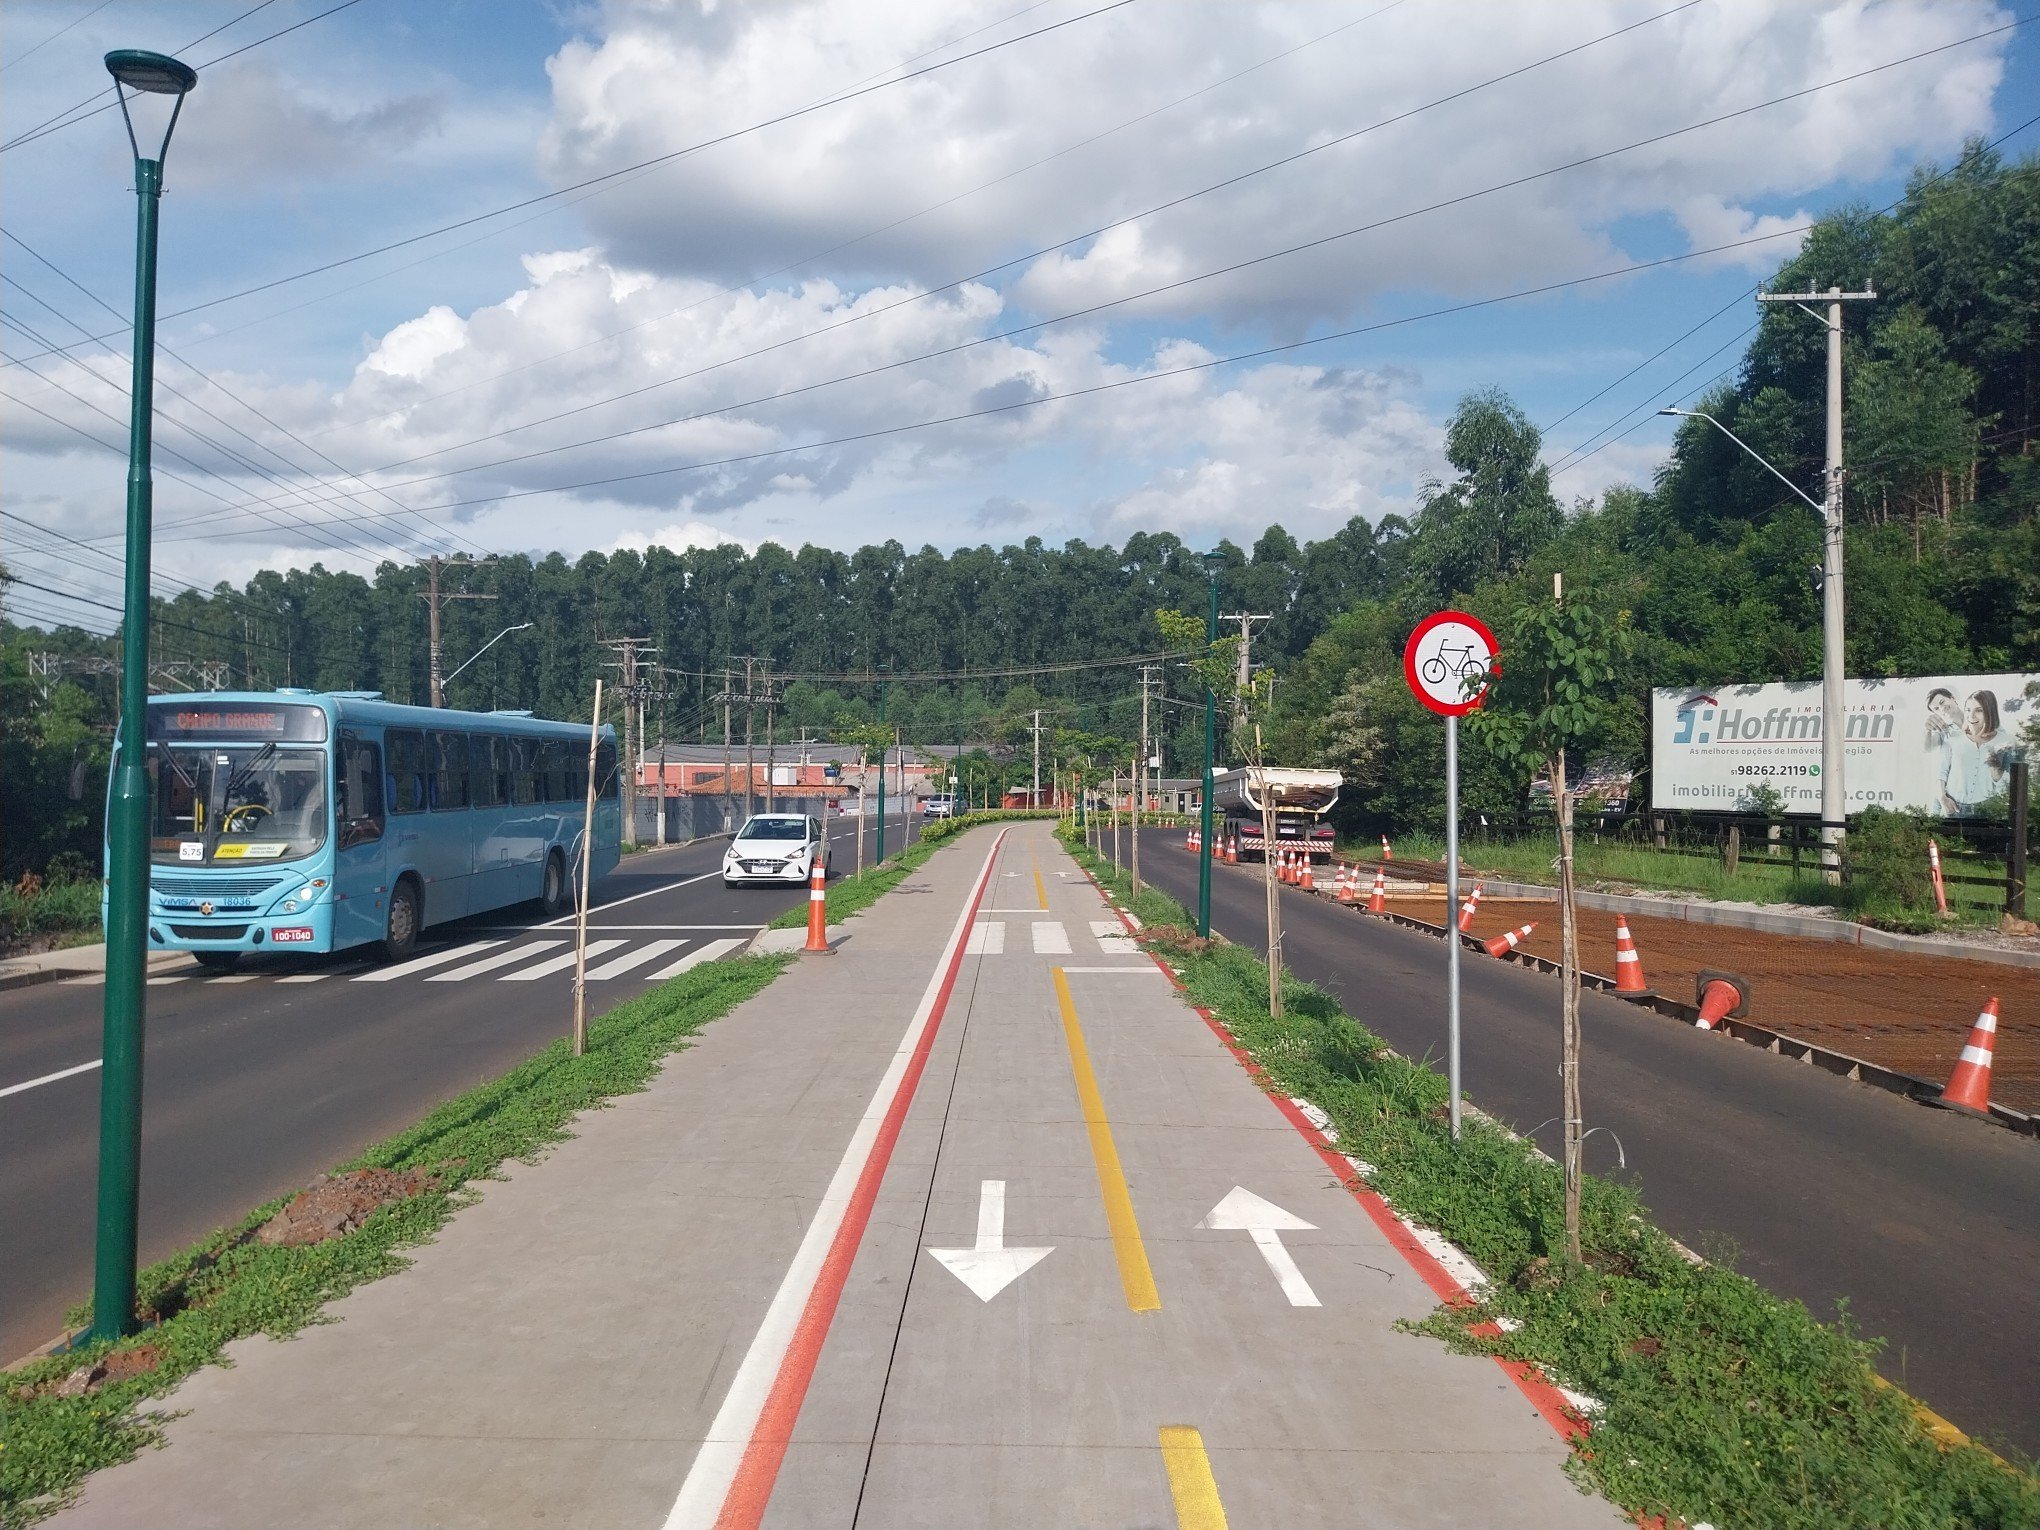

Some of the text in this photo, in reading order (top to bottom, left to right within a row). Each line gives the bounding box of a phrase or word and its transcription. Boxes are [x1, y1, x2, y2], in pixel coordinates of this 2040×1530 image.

[1797, 704, 1895, 713] IMOLIÁRIA
[177, 712, 221, 729] CAMPO
[1717, 707, 1894, 739] Hoffmnn
[1700, 747, 1740, 755] melhores
[1741, 747, 1772, 757] opções
[1774, 747, 1786, 755] de
[1787, 746, 1823, 755] Imóveis
[1845, 746, 1873, 756] egião
[1738, 765, 1807, 776] 98262.2119
[1672, 783, 1894, 802] imobiliariffma.com
[223, 897, 250, 905] 18036
